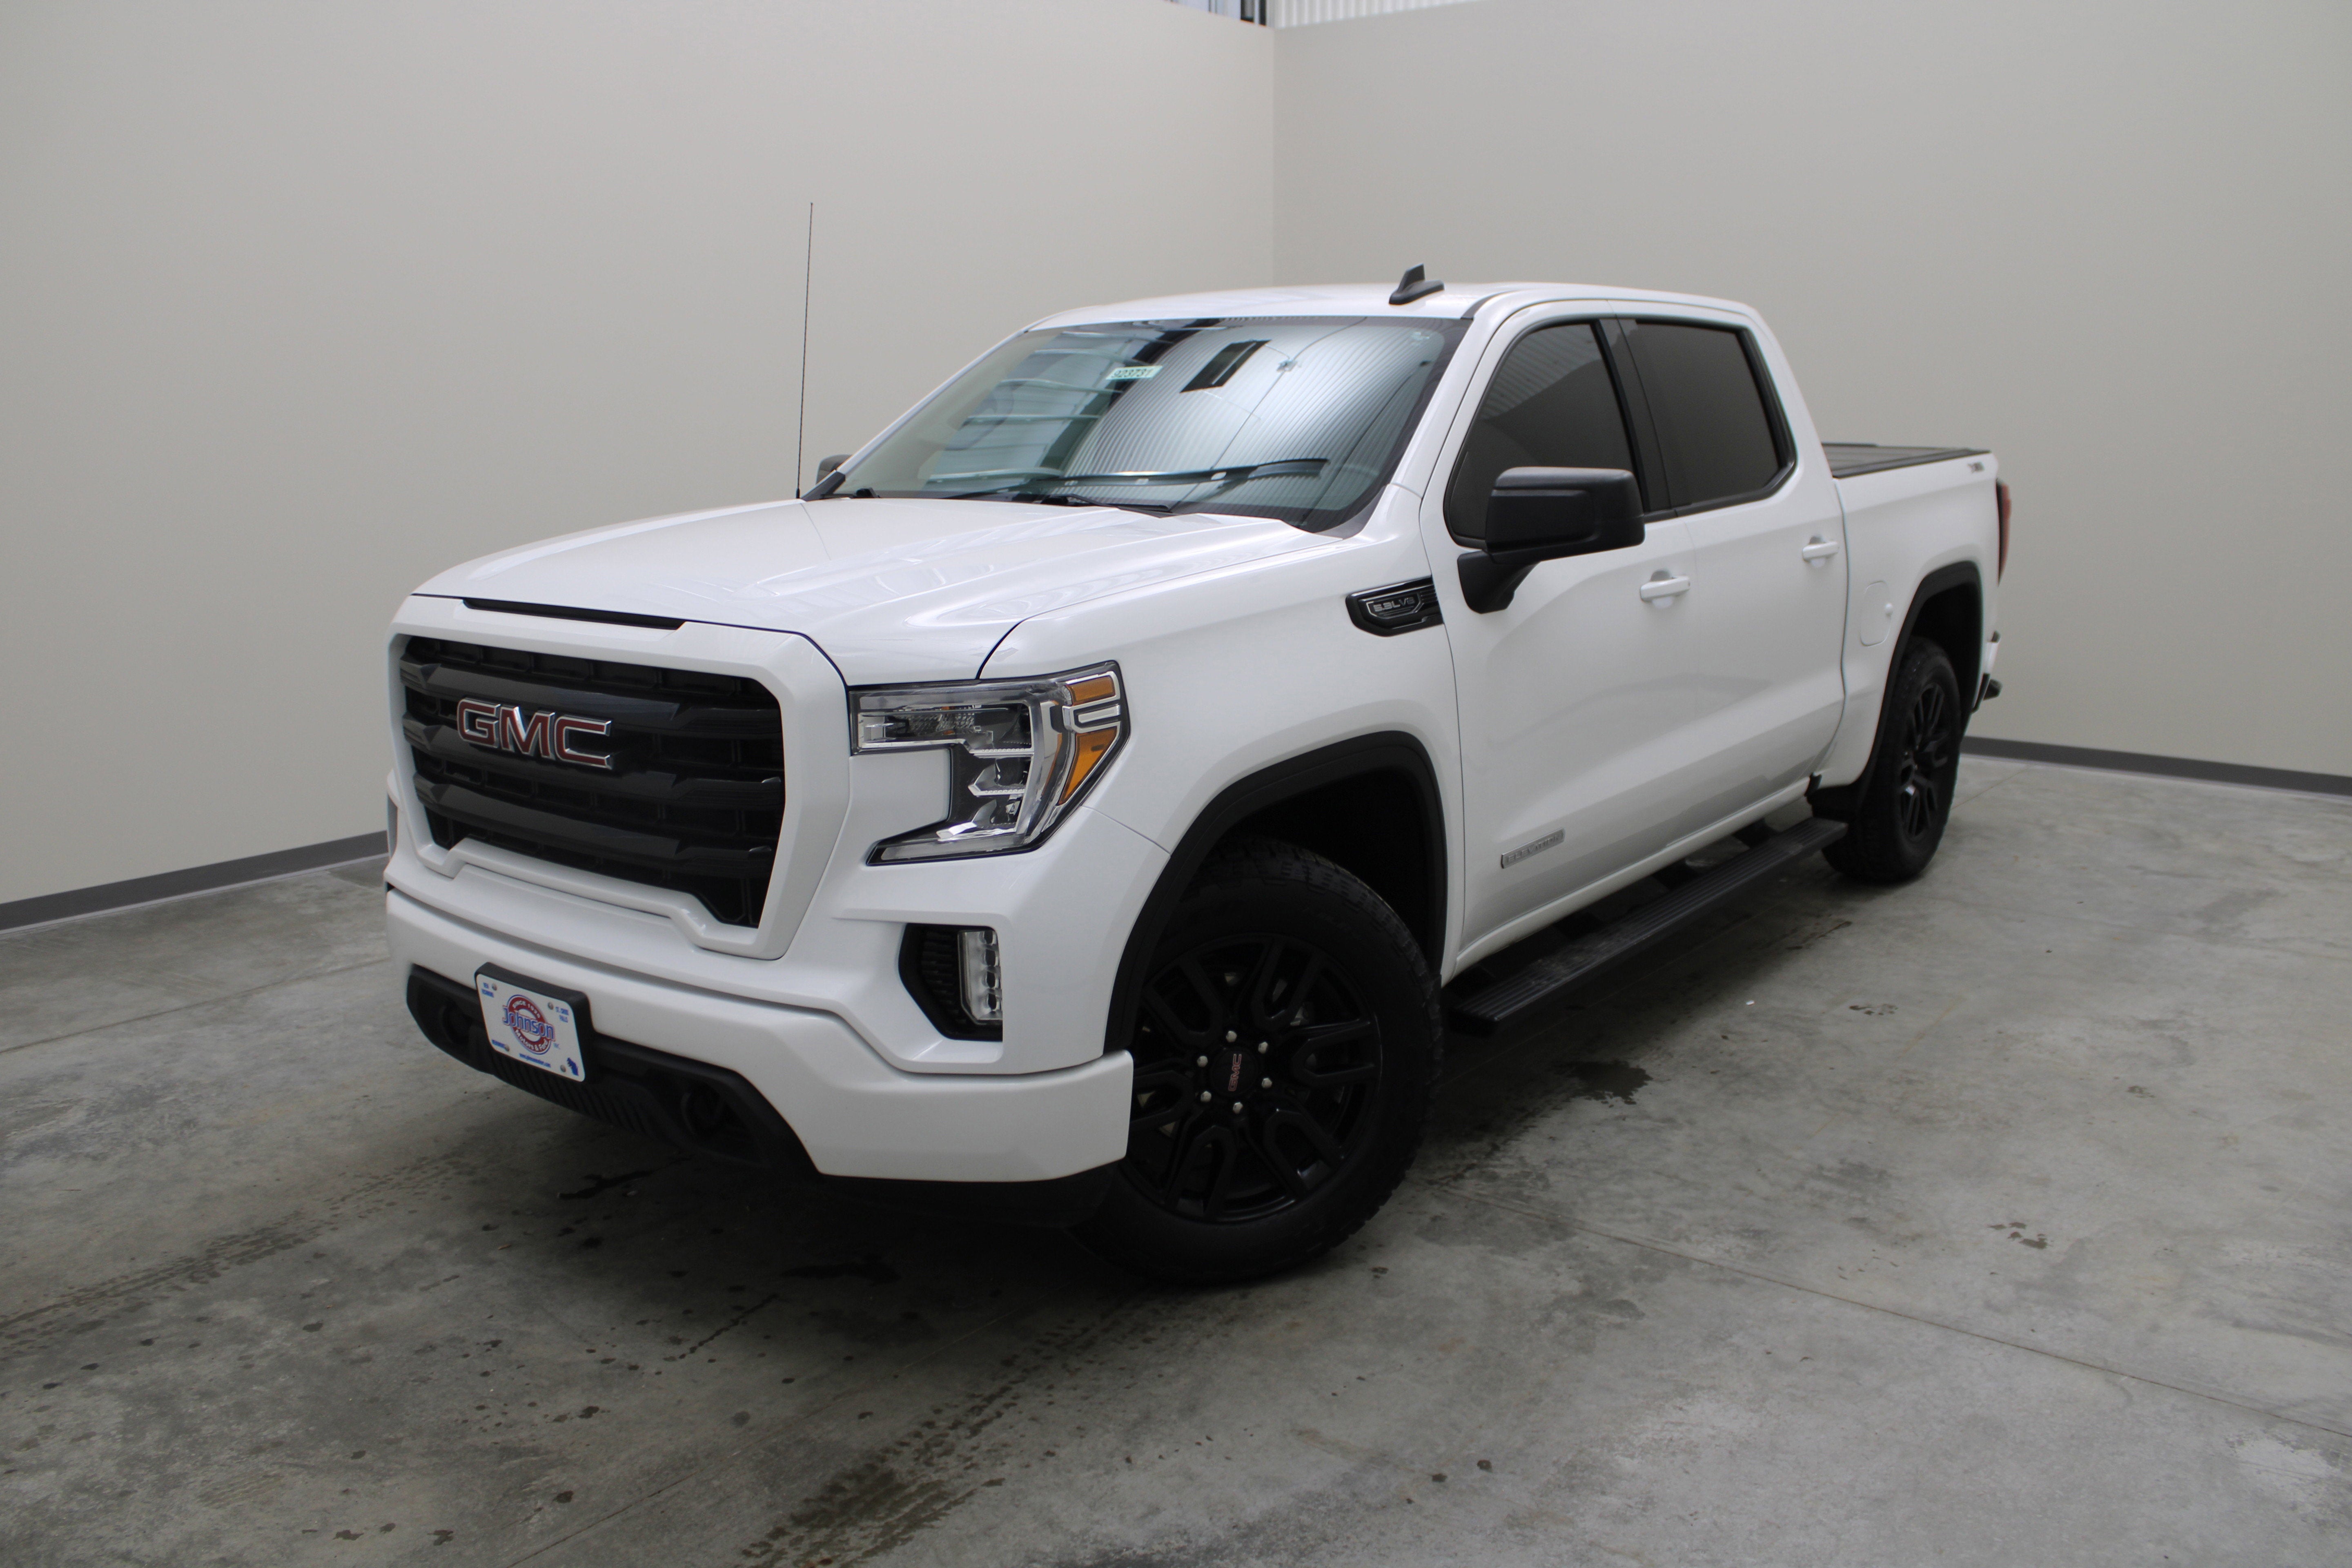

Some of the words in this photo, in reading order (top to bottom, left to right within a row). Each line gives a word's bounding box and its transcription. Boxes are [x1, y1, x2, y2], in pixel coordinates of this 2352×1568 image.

[457, 697, 612, 769] GMC
[502, 1005, 555, 1042] Johnson
[1228, 1054, 1242, 1091] GMC
